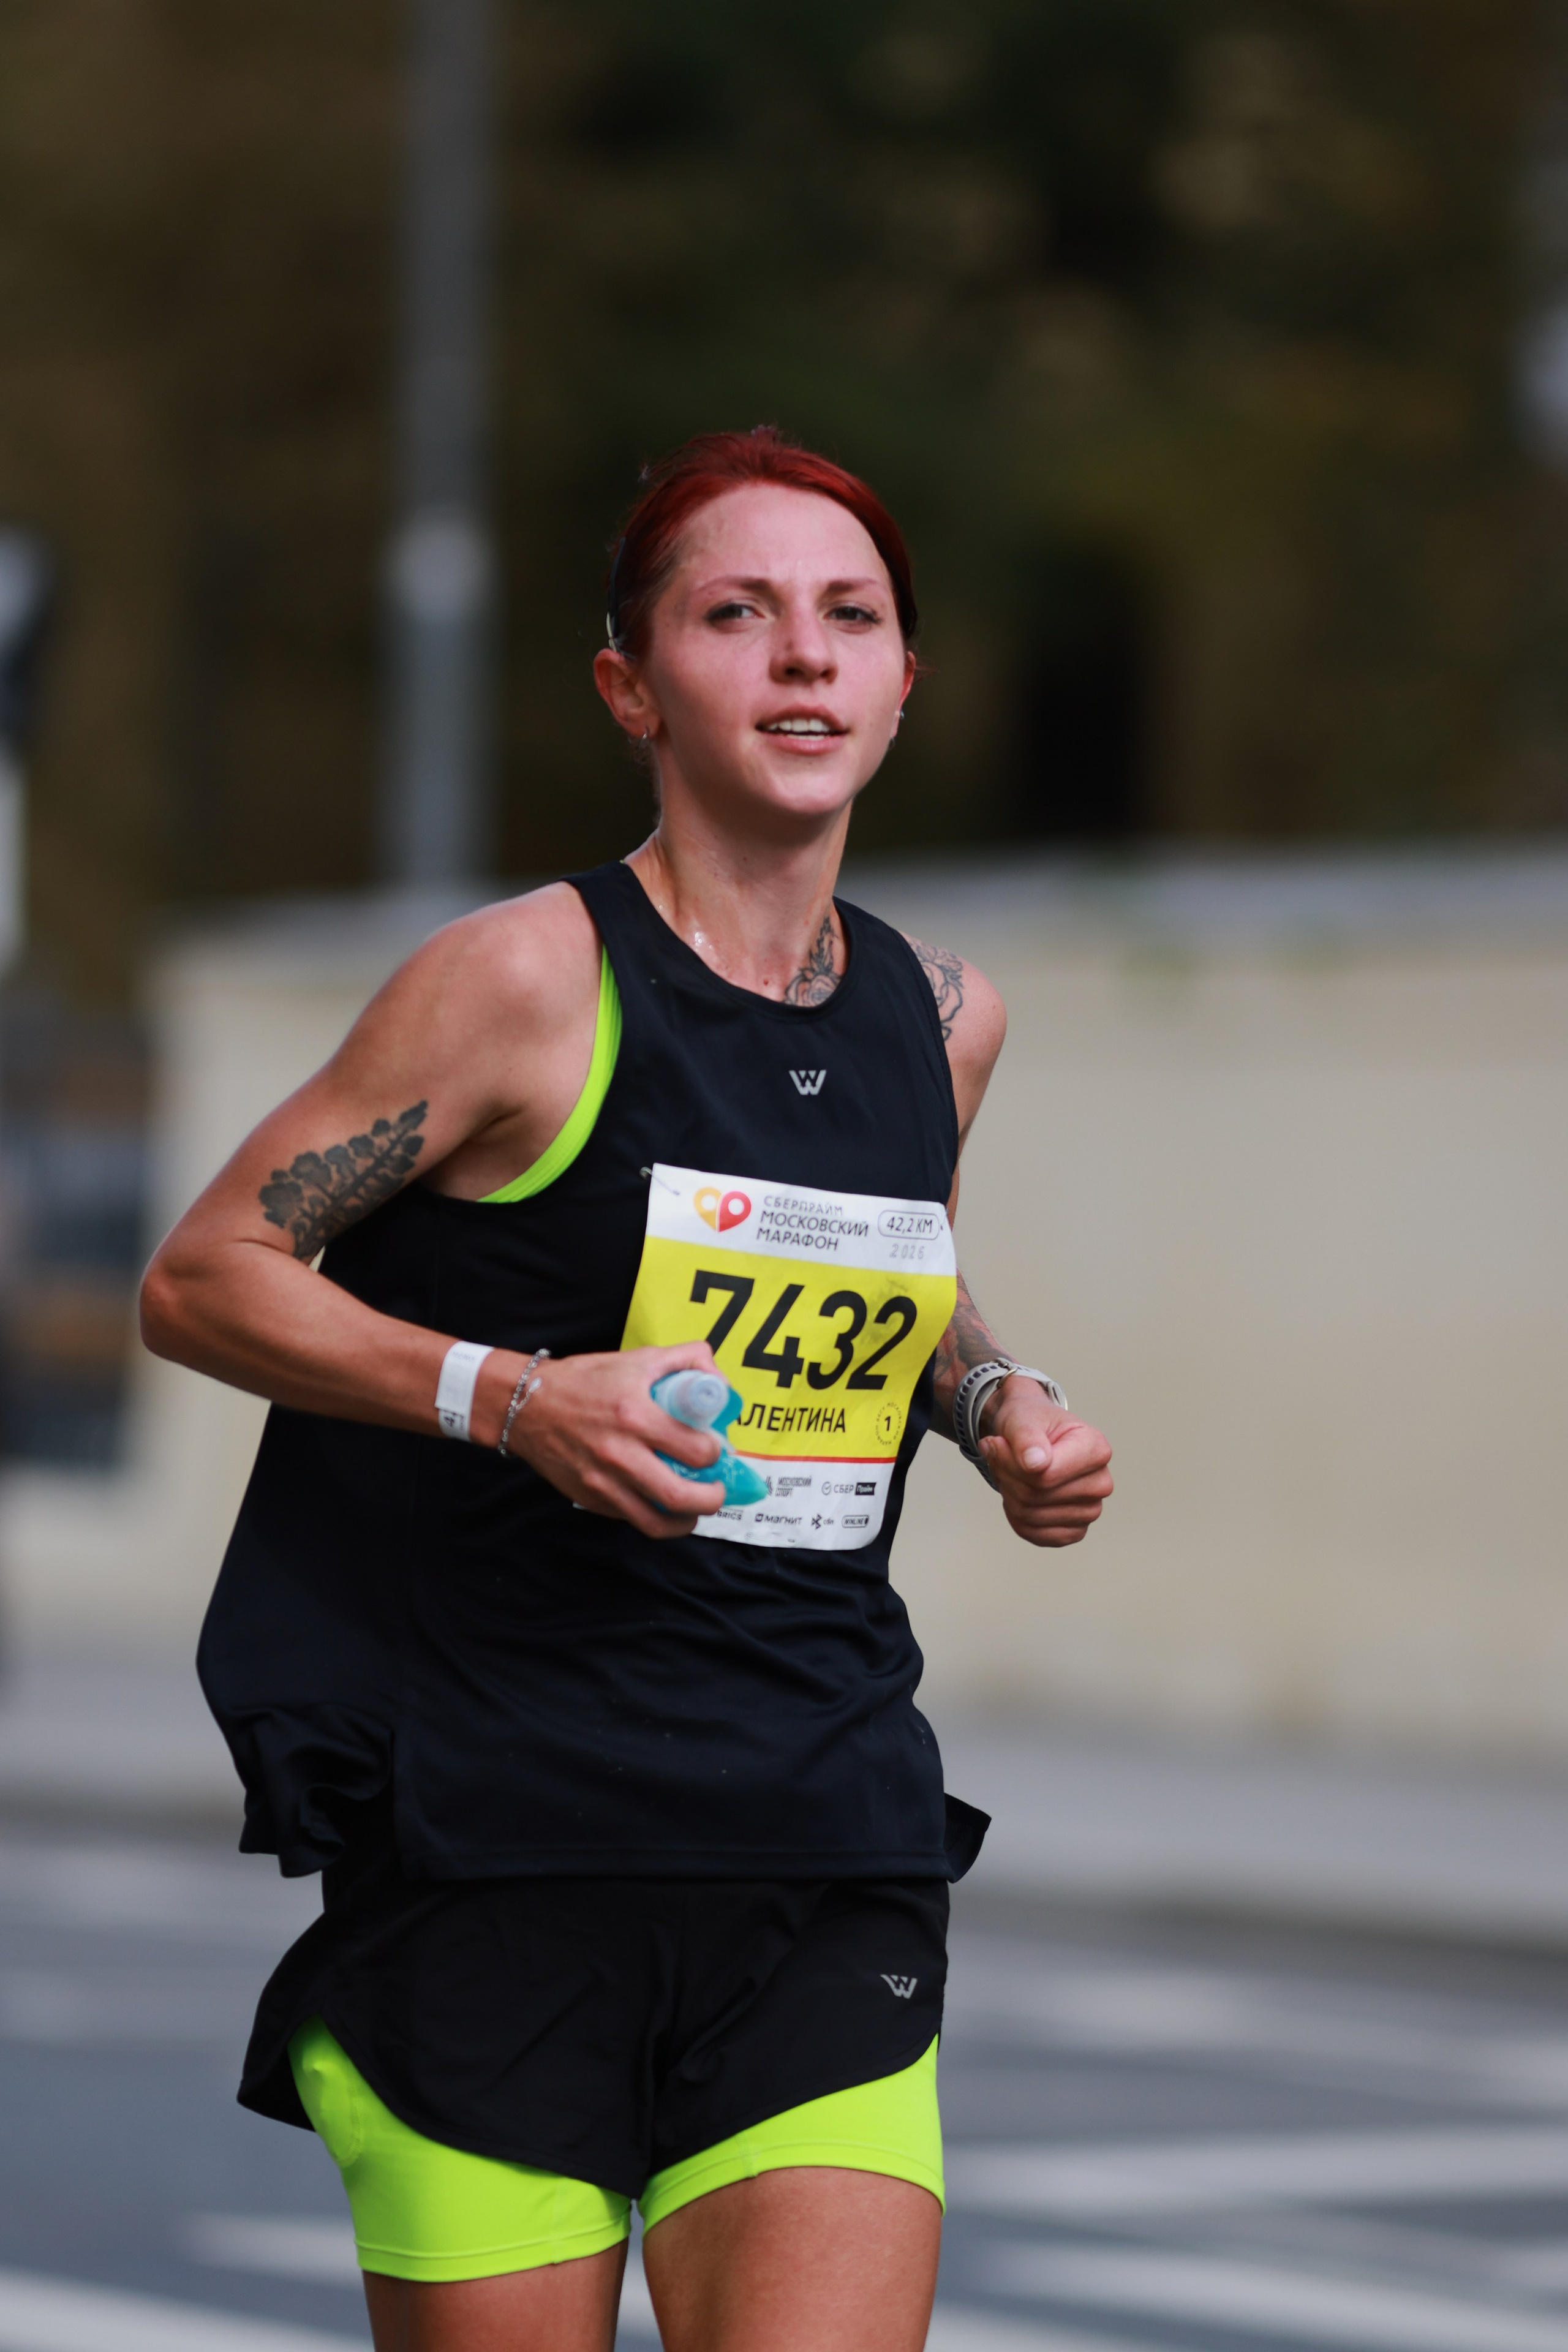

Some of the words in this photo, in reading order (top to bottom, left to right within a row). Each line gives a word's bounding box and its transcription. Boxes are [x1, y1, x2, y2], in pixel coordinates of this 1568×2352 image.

[764, 1195, 843, 1217] СБЕРПРАЙМ
[760, 1210, 869, 1237] МОСКОВСКИЙ
[756, 1227, 839, 1251] МАРАФОН
[688, 1269, 918, 1390] 7432
[736, 1403, 846, 1434] ЛЕНТИНА
[884, 1415, 891, 1432] 1
[833, 1483, 854, 1494] СБЕР
